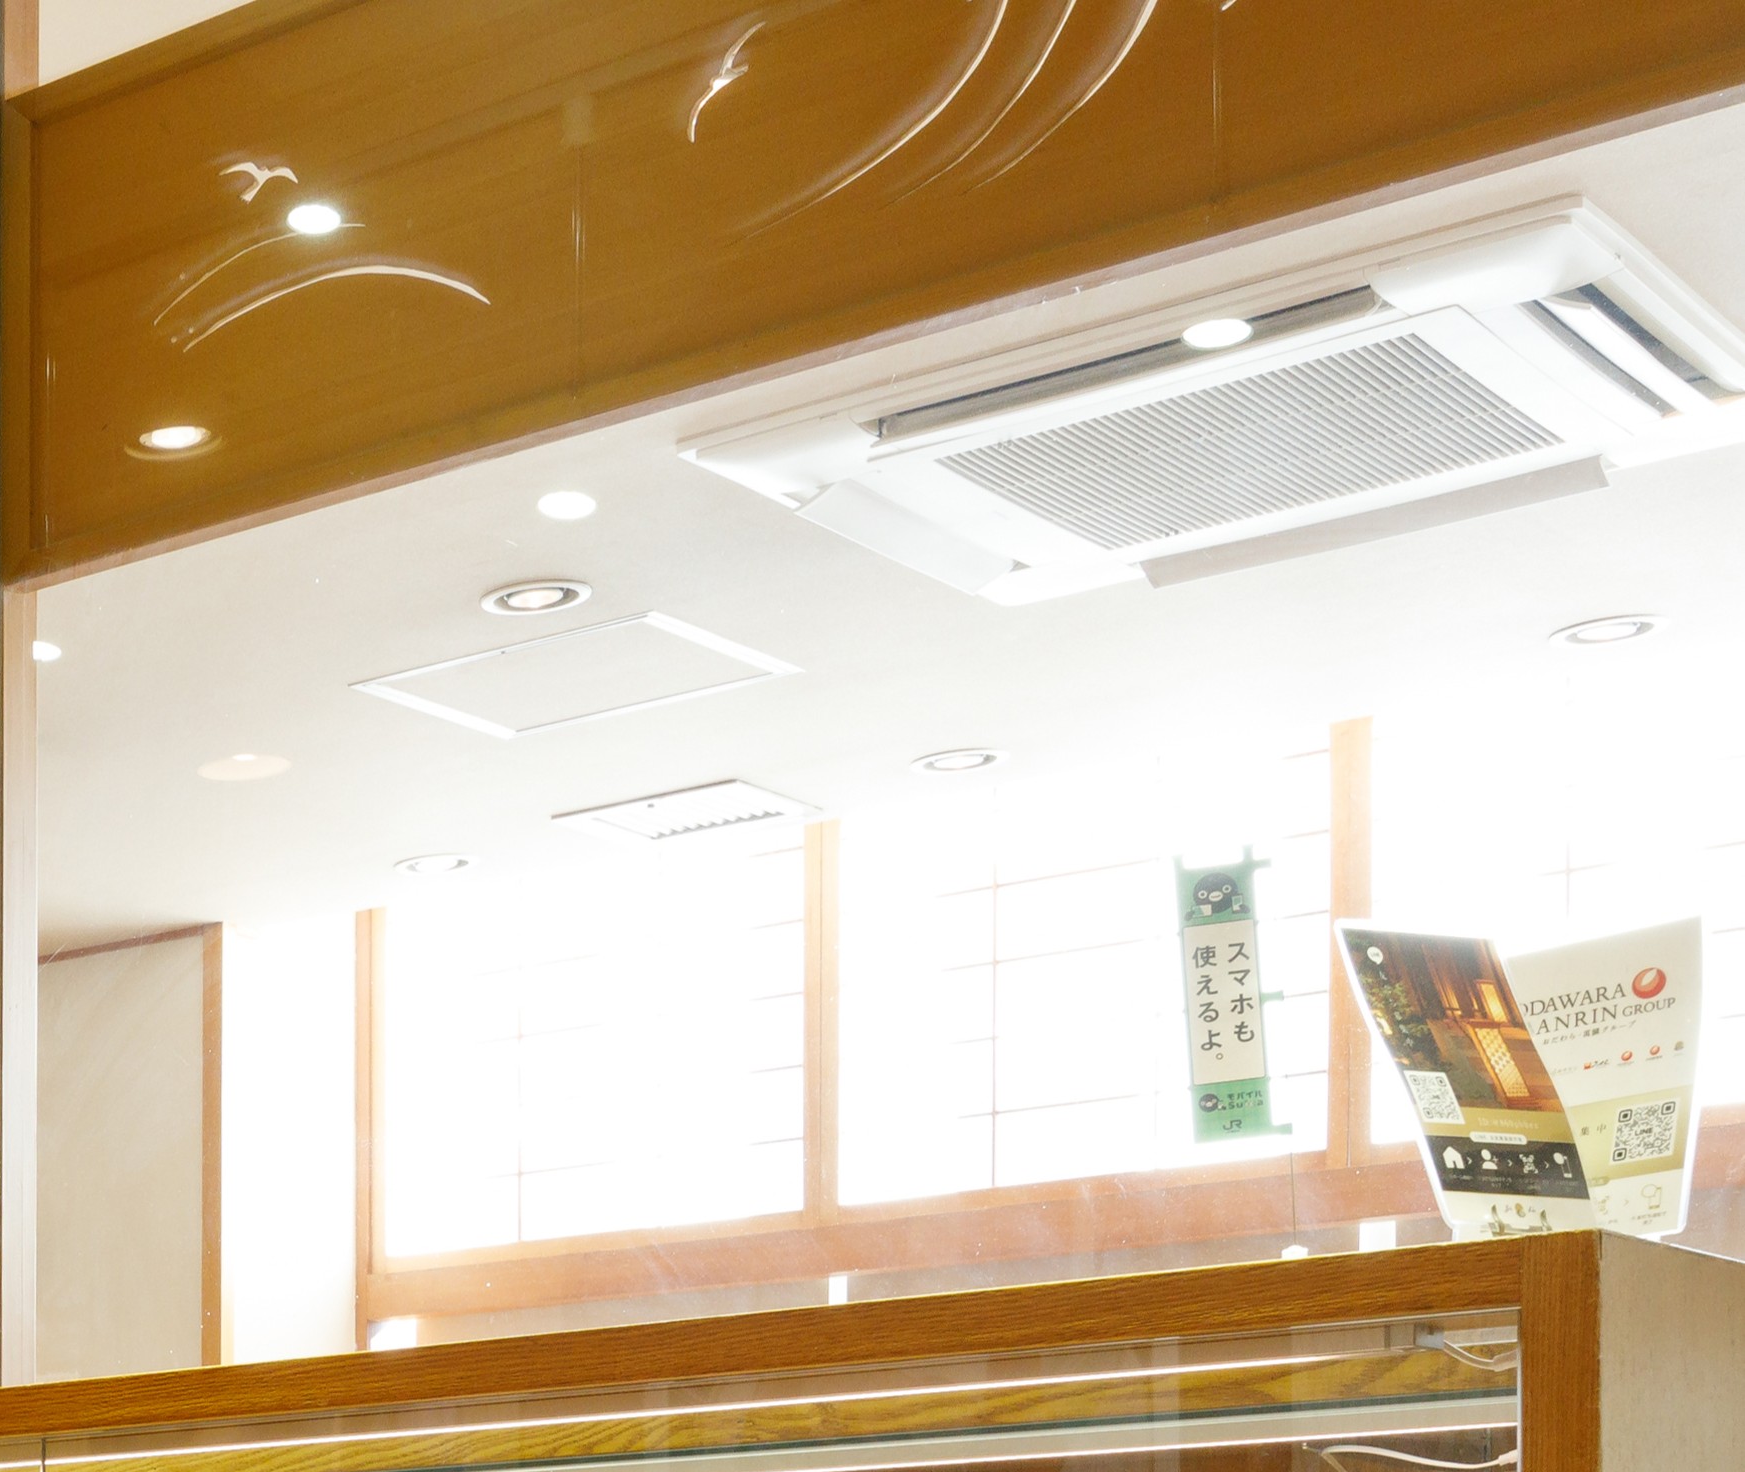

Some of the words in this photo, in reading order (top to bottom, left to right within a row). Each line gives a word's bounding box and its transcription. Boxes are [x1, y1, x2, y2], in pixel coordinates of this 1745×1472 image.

[1192, 945, 1224, 1060] 使えるよ。
[1227, 942, 1255, 1043] スマホも
[1528, 1004, 1619, 1036] ANRIN
[1621, 997, 1677, 1018] GROUP
[1227, 1091, 1263, 1100] モバイル
[1222, 1119, 1243, 1131] JR
